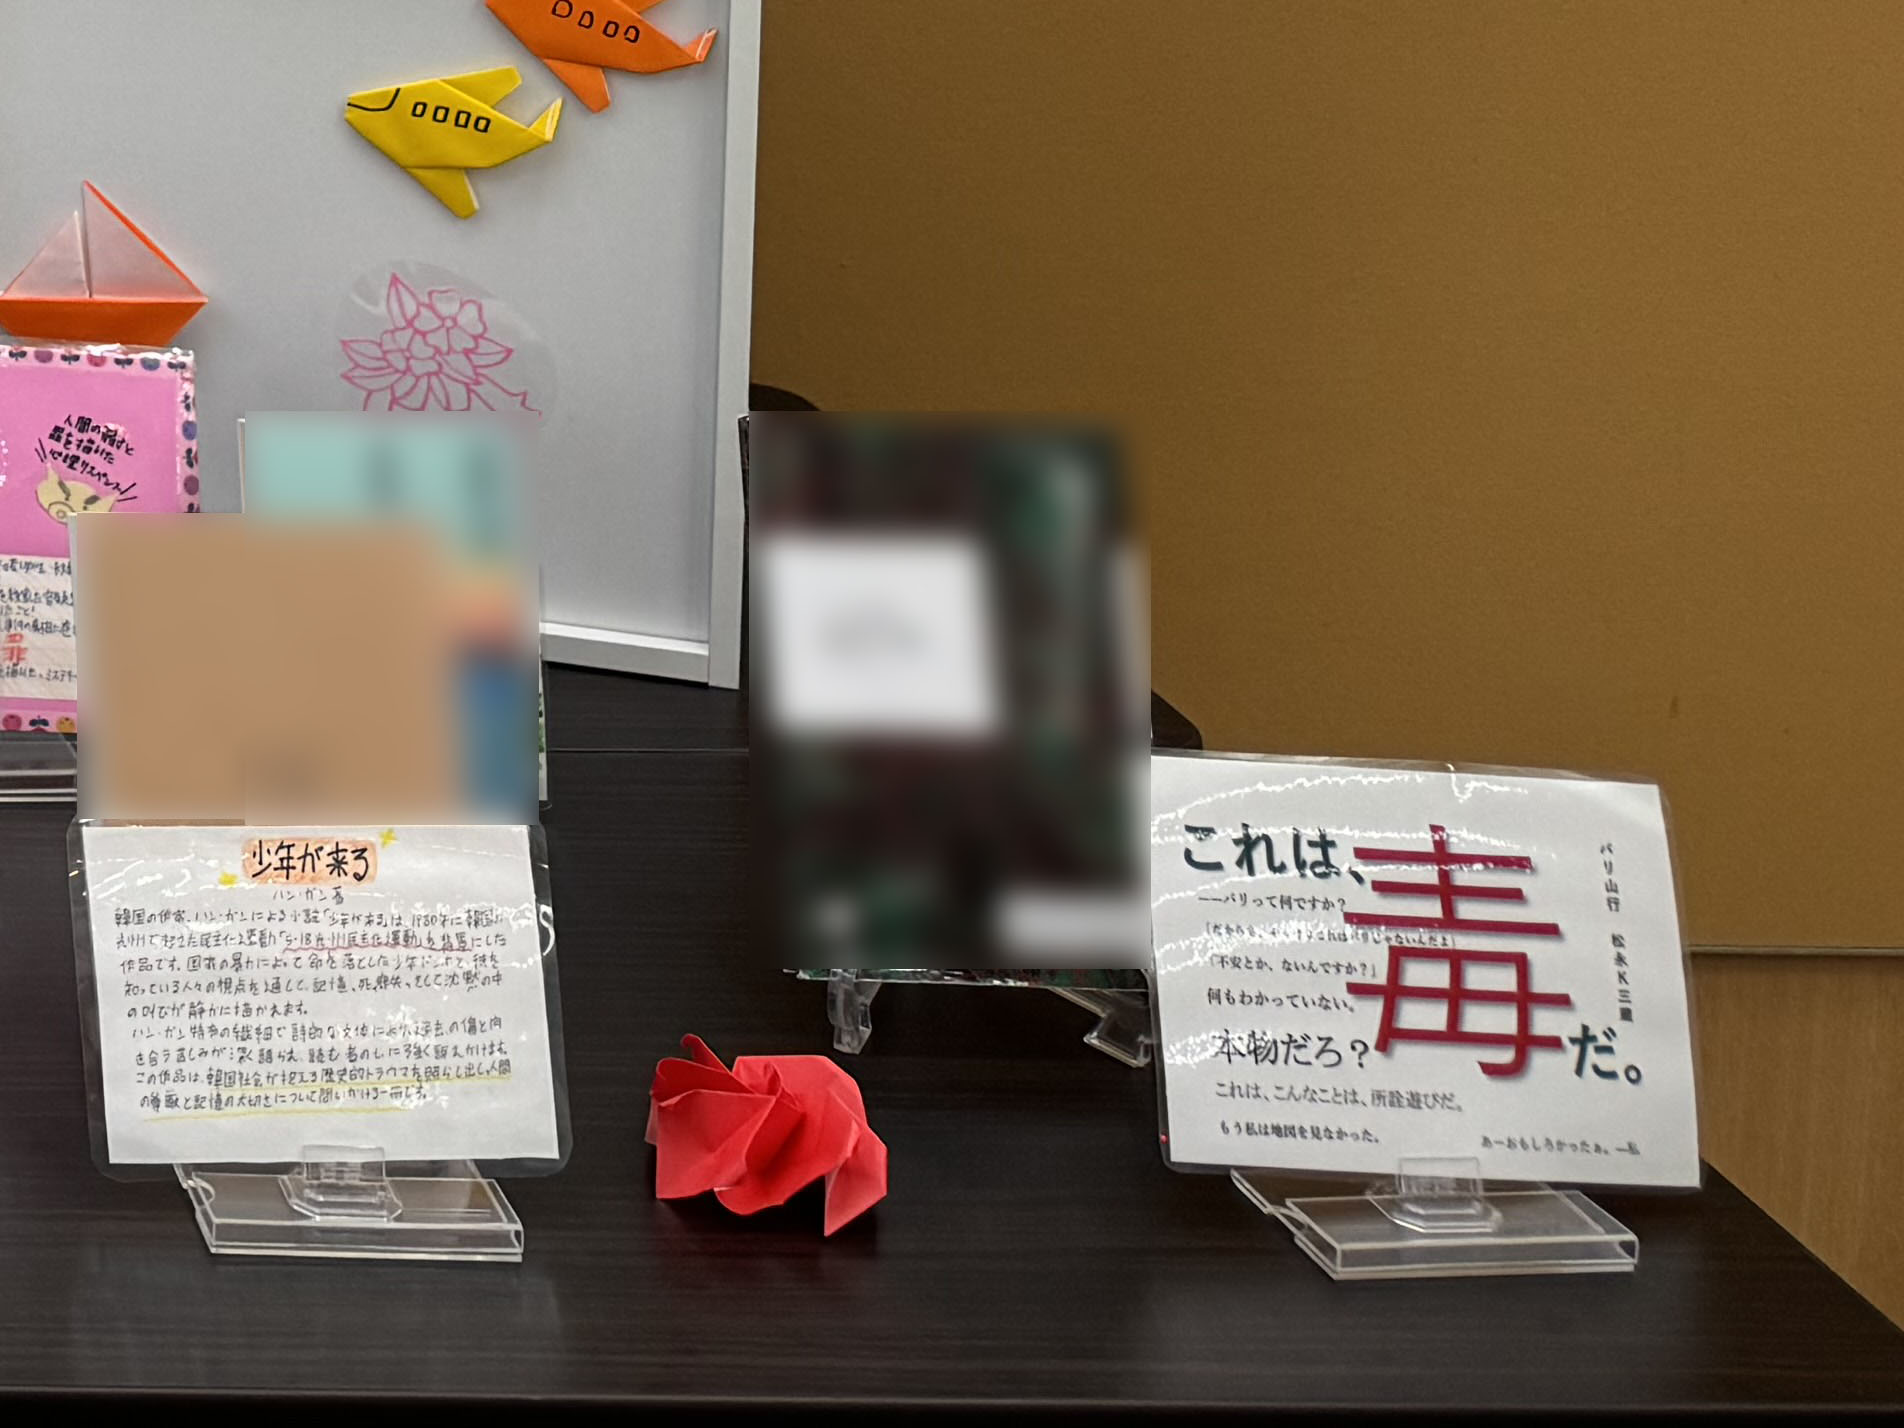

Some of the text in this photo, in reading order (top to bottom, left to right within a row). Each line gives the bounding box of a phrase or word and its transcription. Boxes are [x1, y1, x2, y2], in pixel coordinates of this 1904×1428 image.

[251, 840, 369, 882] 少年が来る
[1183, 822, 1367, 885] これは、
[1344, 823, 1572, 1081] 毒
[1567, 1022, 1643, 1086] だ。
[1207, 988, 1356, 1013] 何もわかっていない。
[1215, 1028, 1371, 1069] 本物だろ？
[1216, 1080, 1464, 1113] これは、こんなことは、所詮遊びだ。
